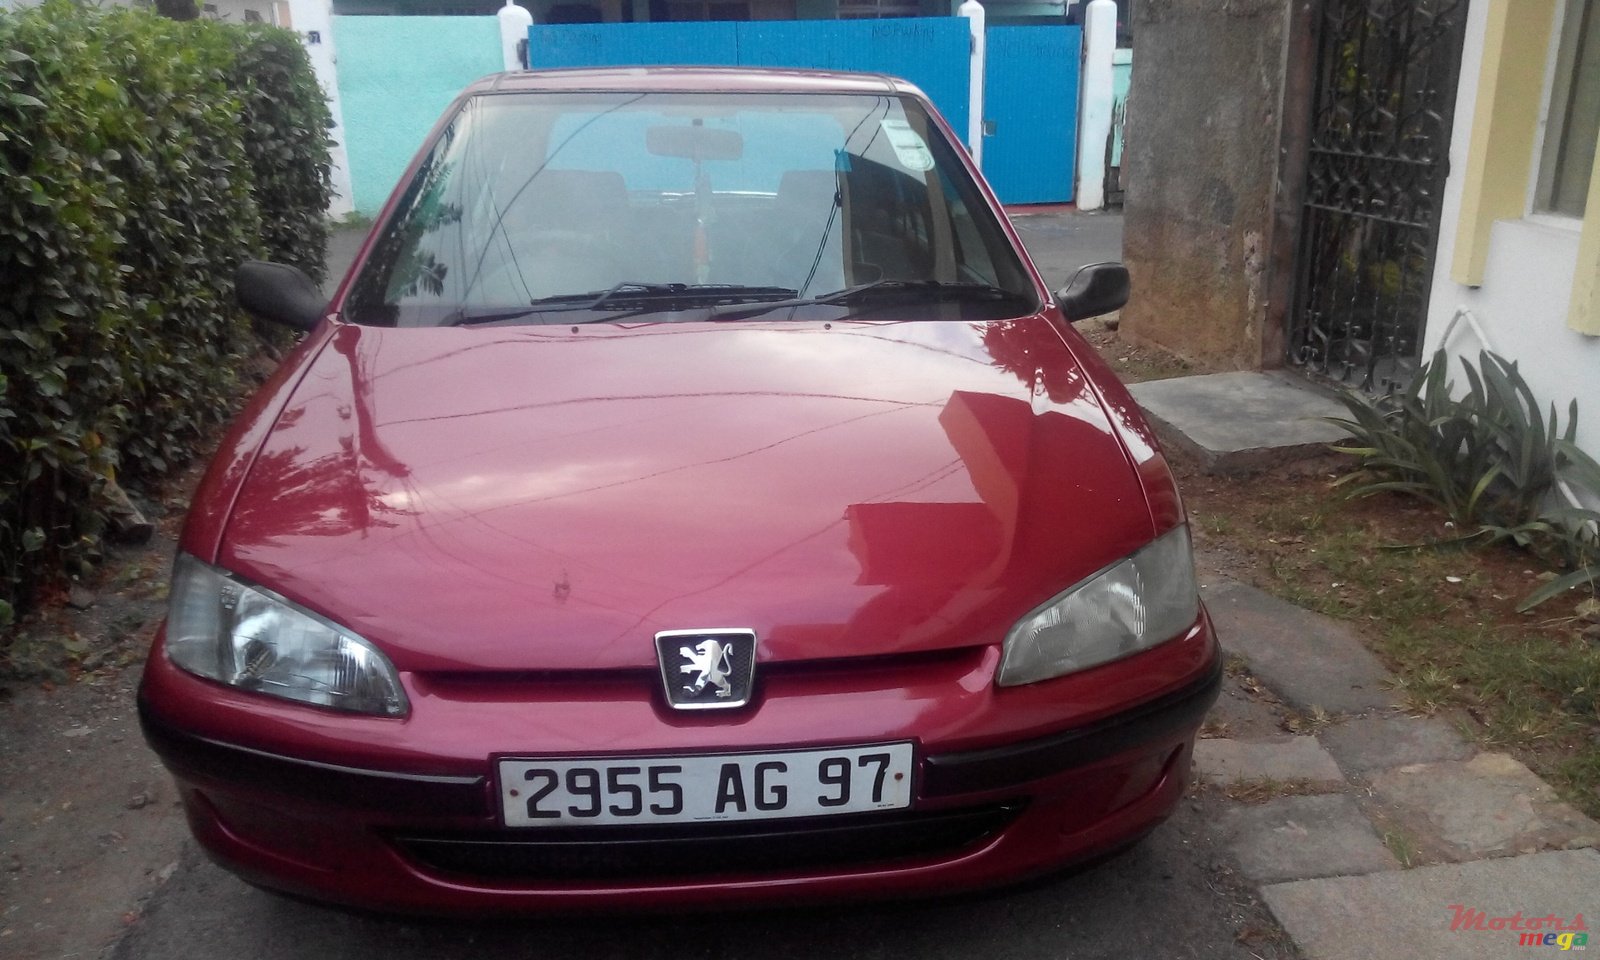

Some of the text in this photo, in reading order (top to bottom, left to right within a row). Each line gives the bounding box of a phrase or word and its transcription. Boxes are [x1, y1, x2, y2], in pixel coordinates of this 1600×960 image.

[524, 753, 891, 819] 2955 AG 97
